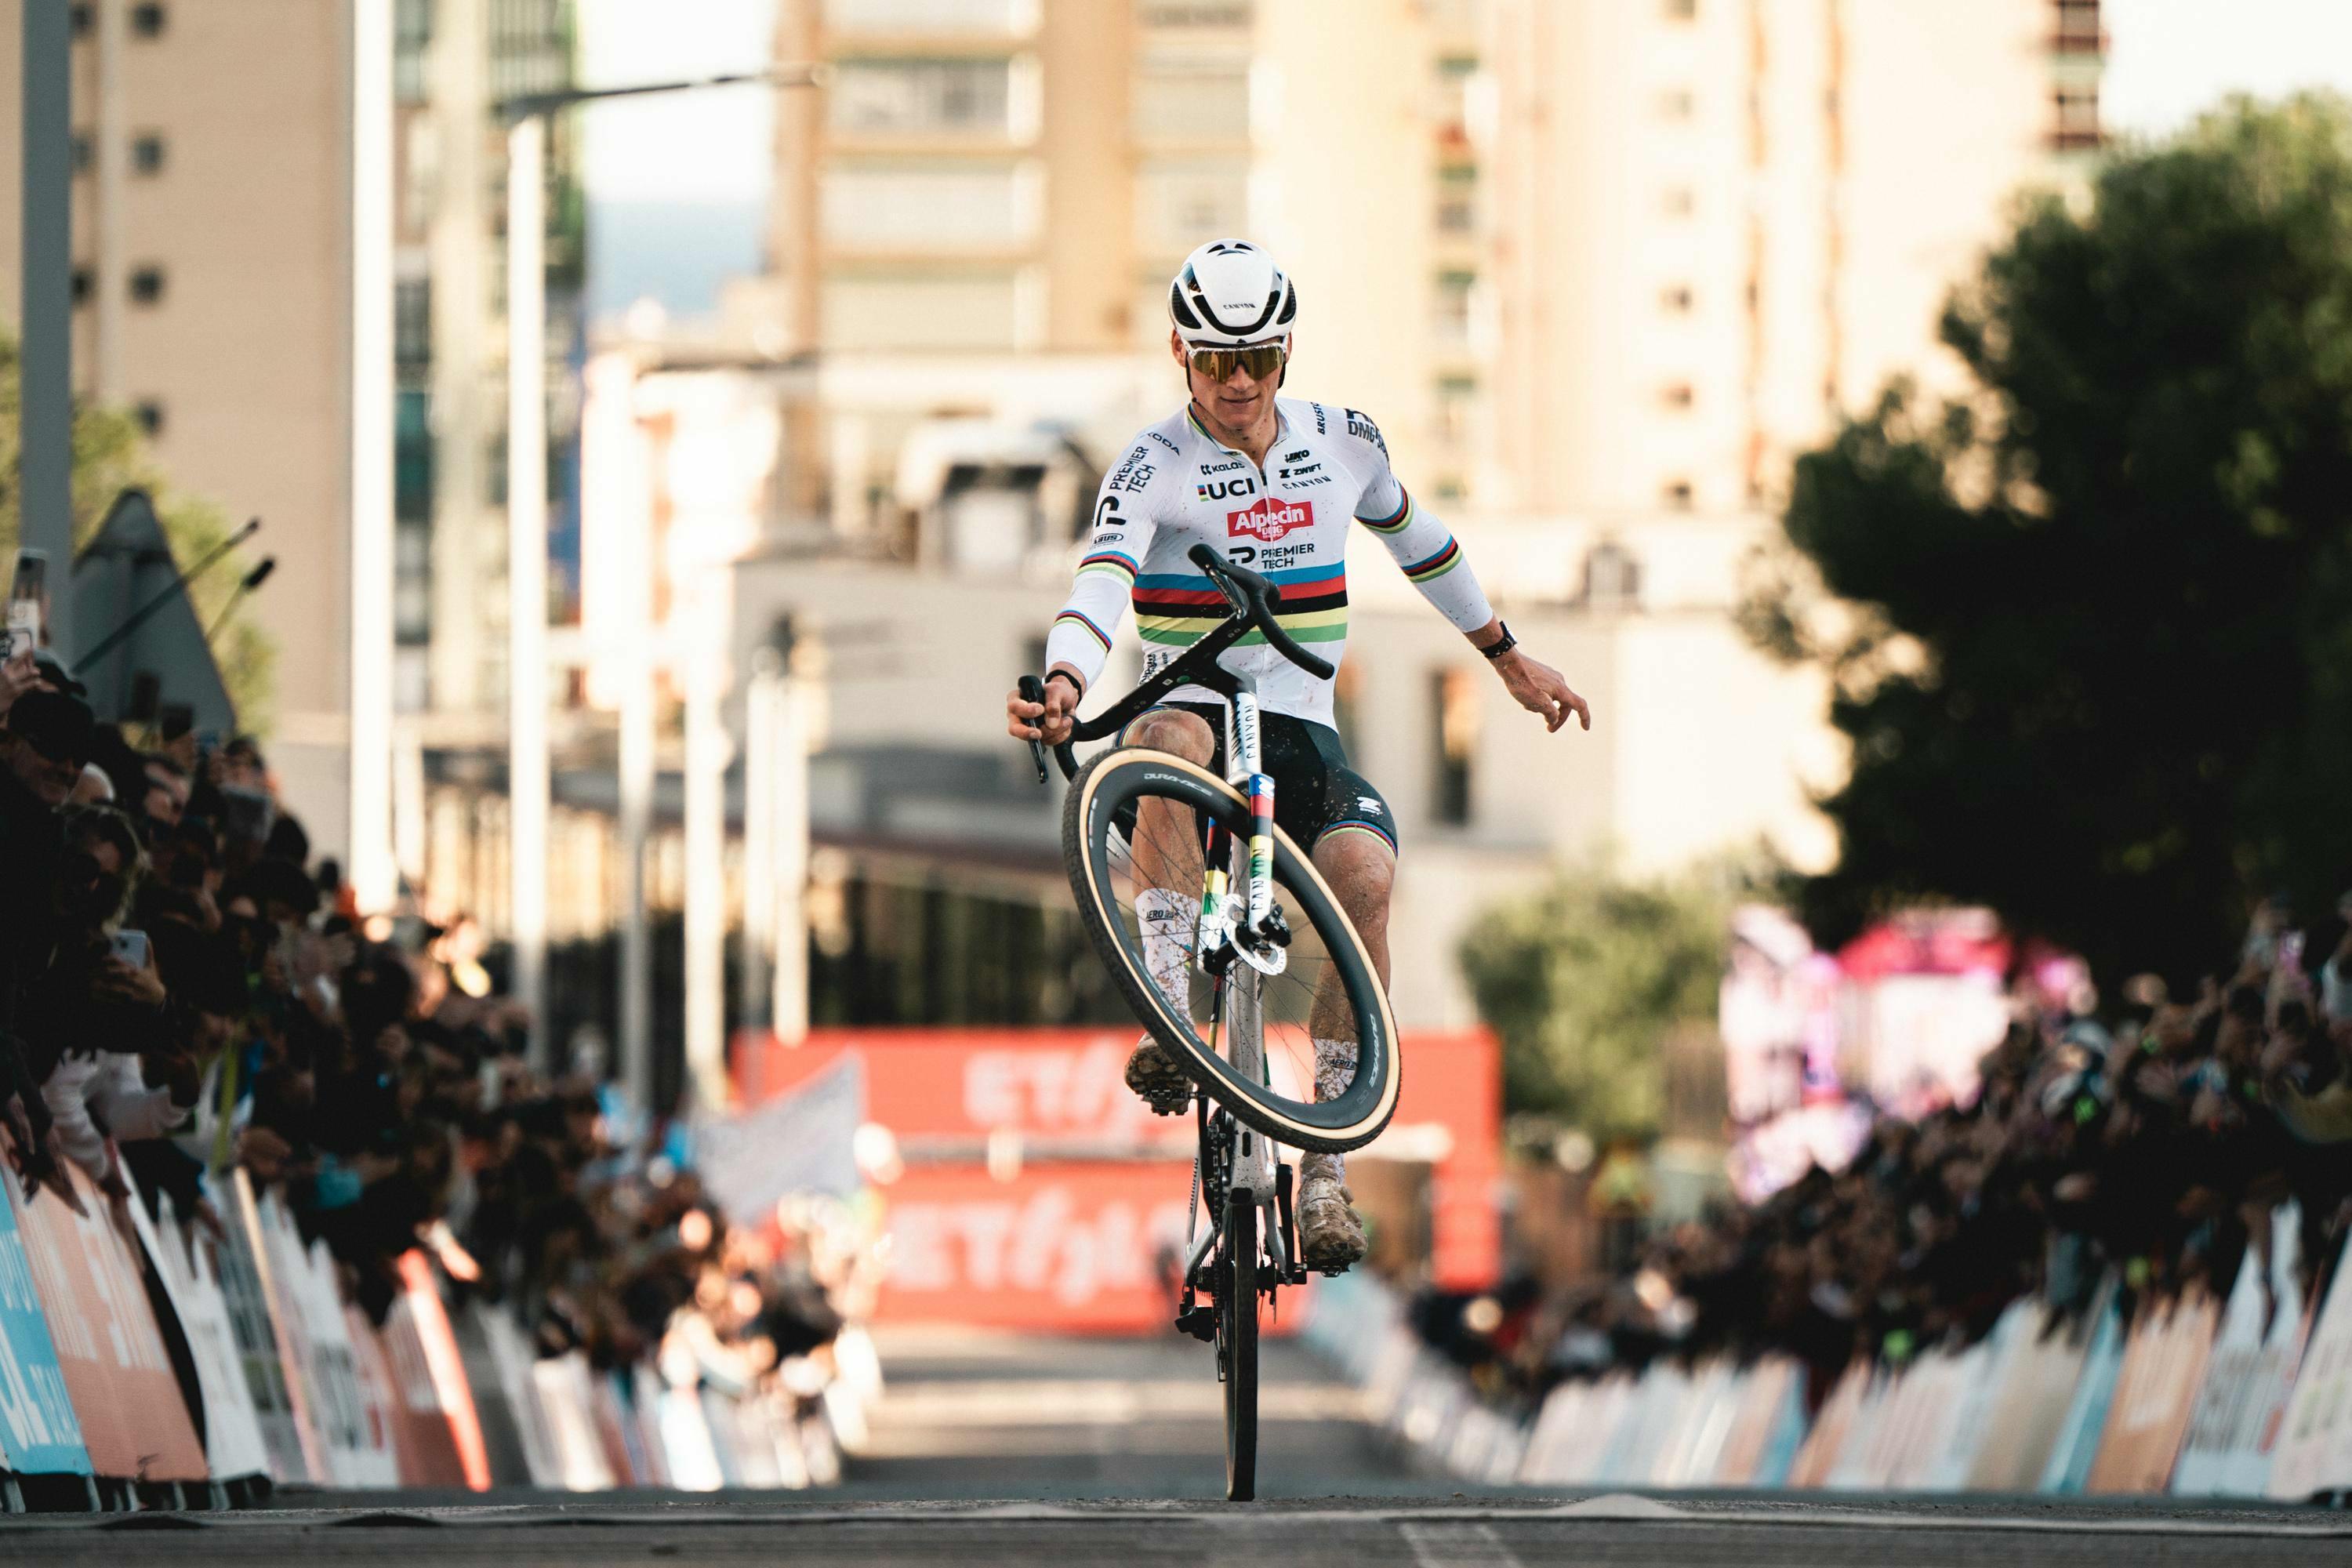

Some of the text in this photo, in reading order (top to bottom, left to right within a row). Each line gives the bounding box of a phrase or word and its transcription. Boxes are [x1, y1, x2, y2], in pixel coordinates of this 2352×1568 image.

[1310, 401, 1325, 435] BRUSTO
[1109, 446, 1149, 490] PREMIER
[1126, 464, 1156, 492] TECH
[1293, 463, 1321, 475] ZWIFT
[1207, 477, 1255, 499] UCI
[1282, 475, 1331, 489] CANYON
[1235, 506, 1305, 532] Alpecin
[1261, 543, 1315, 558] PREMIER
[1261, 557, 1294, 568] TECH
[1244, 705, 1256, 759] CANYON
[1251, 848, 1265, 911] CANYON
